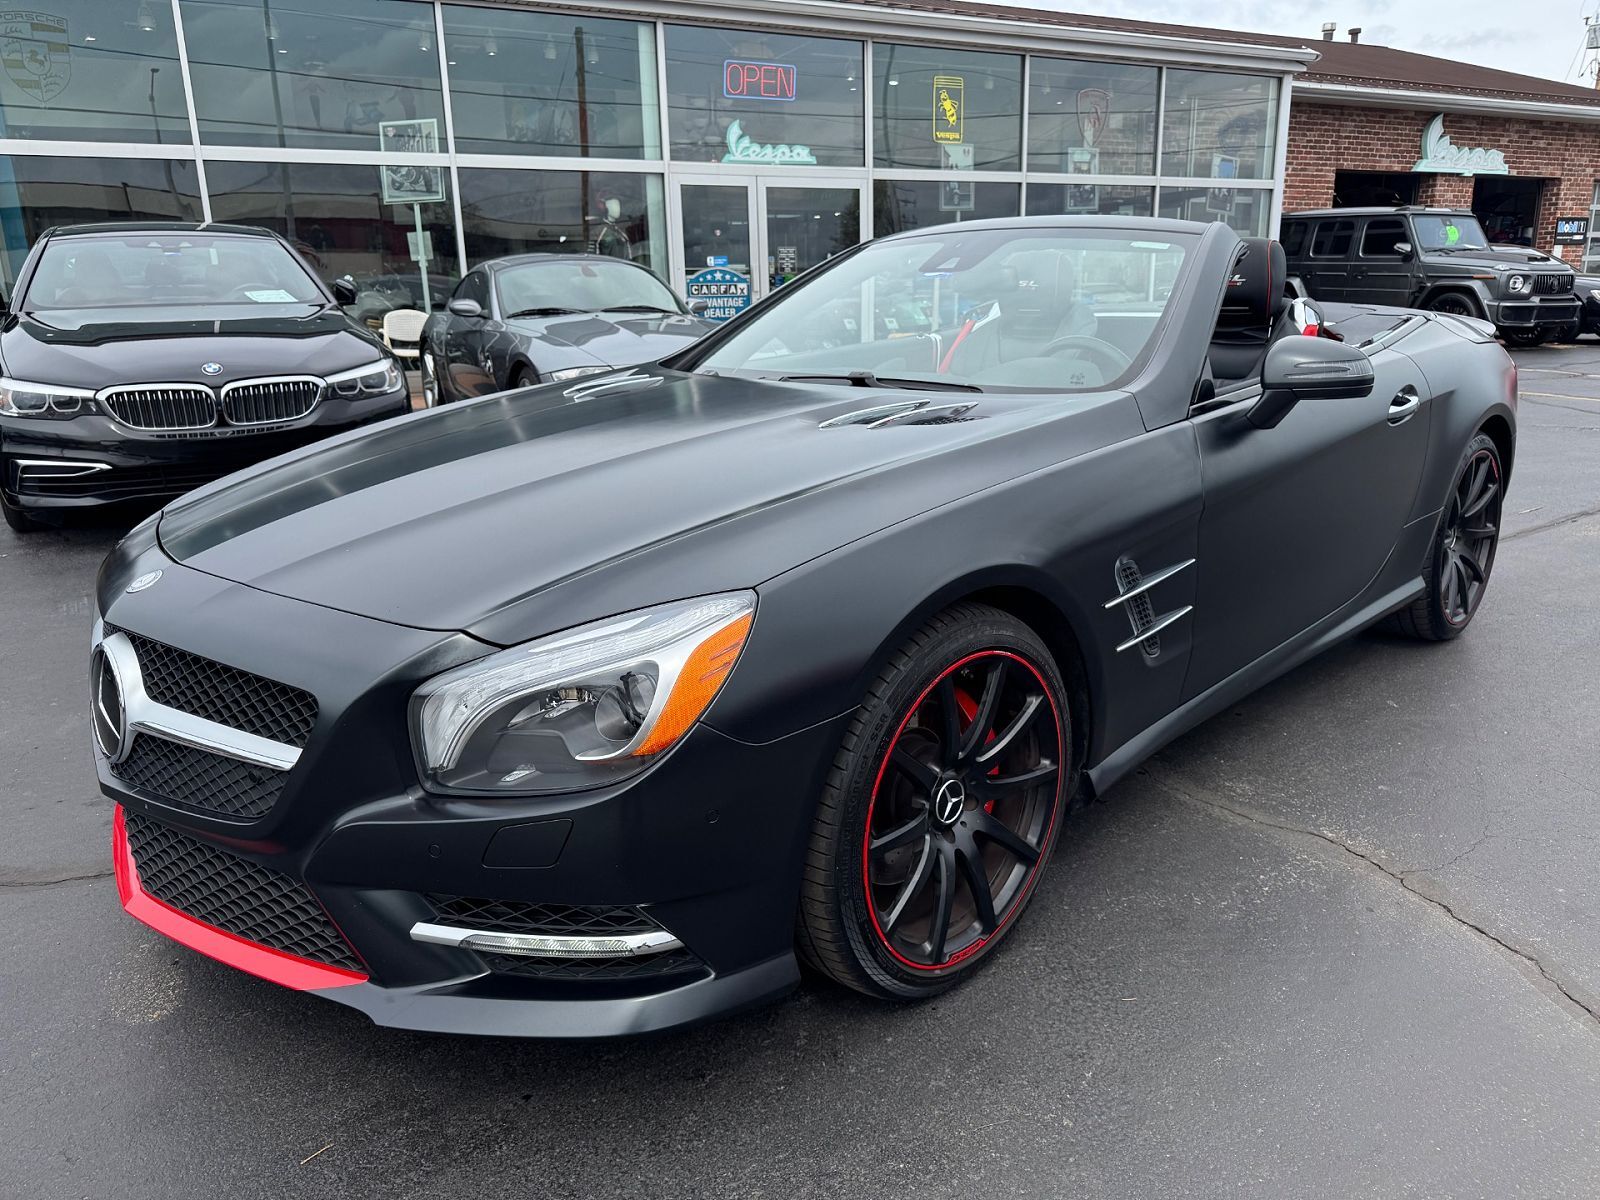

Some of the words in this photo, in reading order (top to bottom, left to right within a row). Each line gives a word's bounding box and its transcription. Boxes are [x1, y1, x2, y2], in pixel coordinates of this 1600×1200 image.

[727, 64, 793, 97] OPEN
[726, 119, 812, 163] Vespa
[1557, 221, 1579, 233] Mobil
[691, 284, 748, 296] CARFAX
[704, 297, 744, 308] VANTAGE
[704, 308, 736, 318] DEALER
